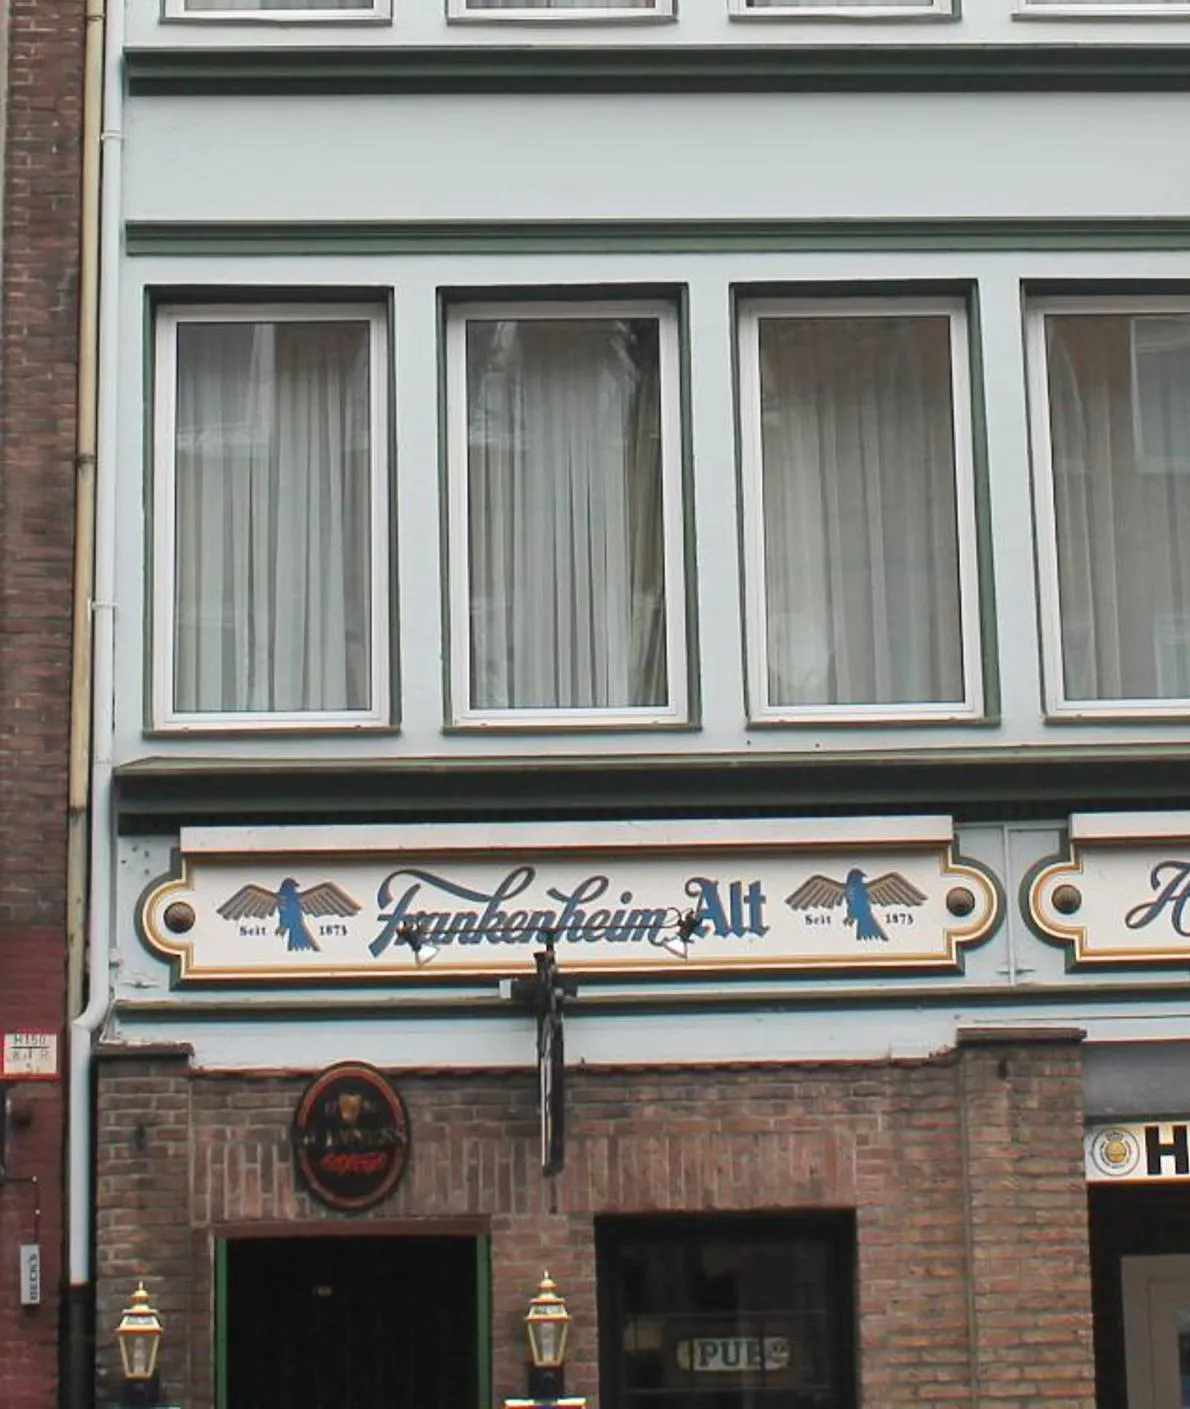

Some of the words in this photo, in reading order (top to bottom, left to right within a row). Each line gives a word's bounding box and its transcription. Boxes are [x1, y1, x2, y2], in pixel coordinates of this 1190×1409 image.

[367, 865, 669, 959] Frankenheim
[684, 876, 771, 940] Alt
[805, 914, 832, 926] Seit
[239, 925, 267, 937] Seit
